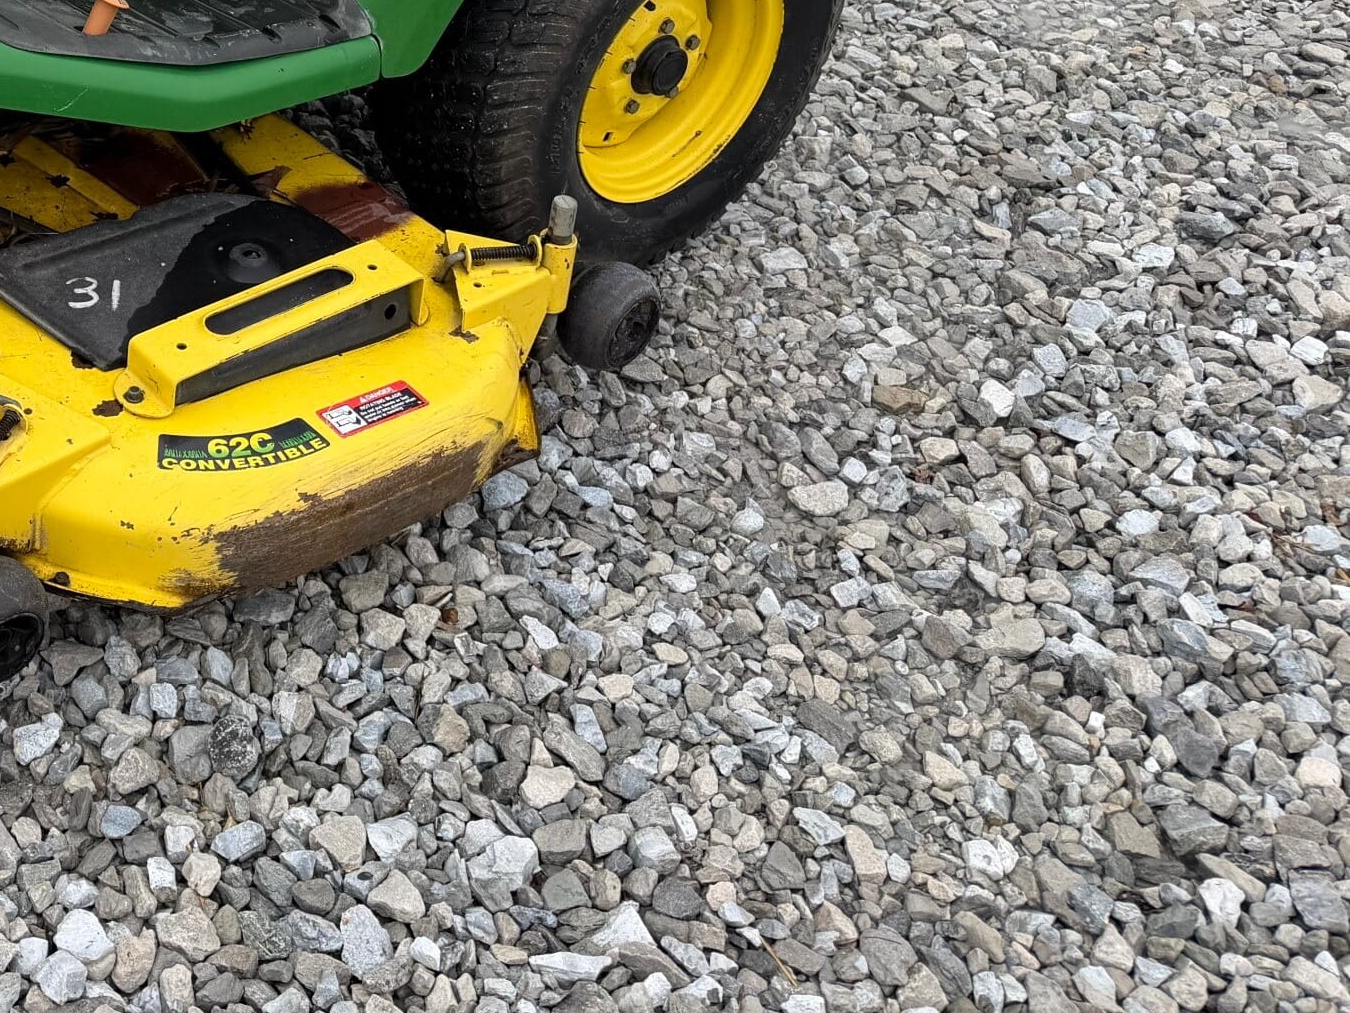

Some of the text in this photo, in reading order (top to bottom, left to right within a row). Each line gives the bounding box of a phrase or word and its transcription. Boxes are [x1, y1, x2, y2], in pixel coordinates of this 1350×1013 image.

[65, 276, 121, 311] 31
[365, 386, 394, 400] DANGER
[161, 438, 327, 471] CONVERTIBLE
[207, 432, 275, 459] 62C
